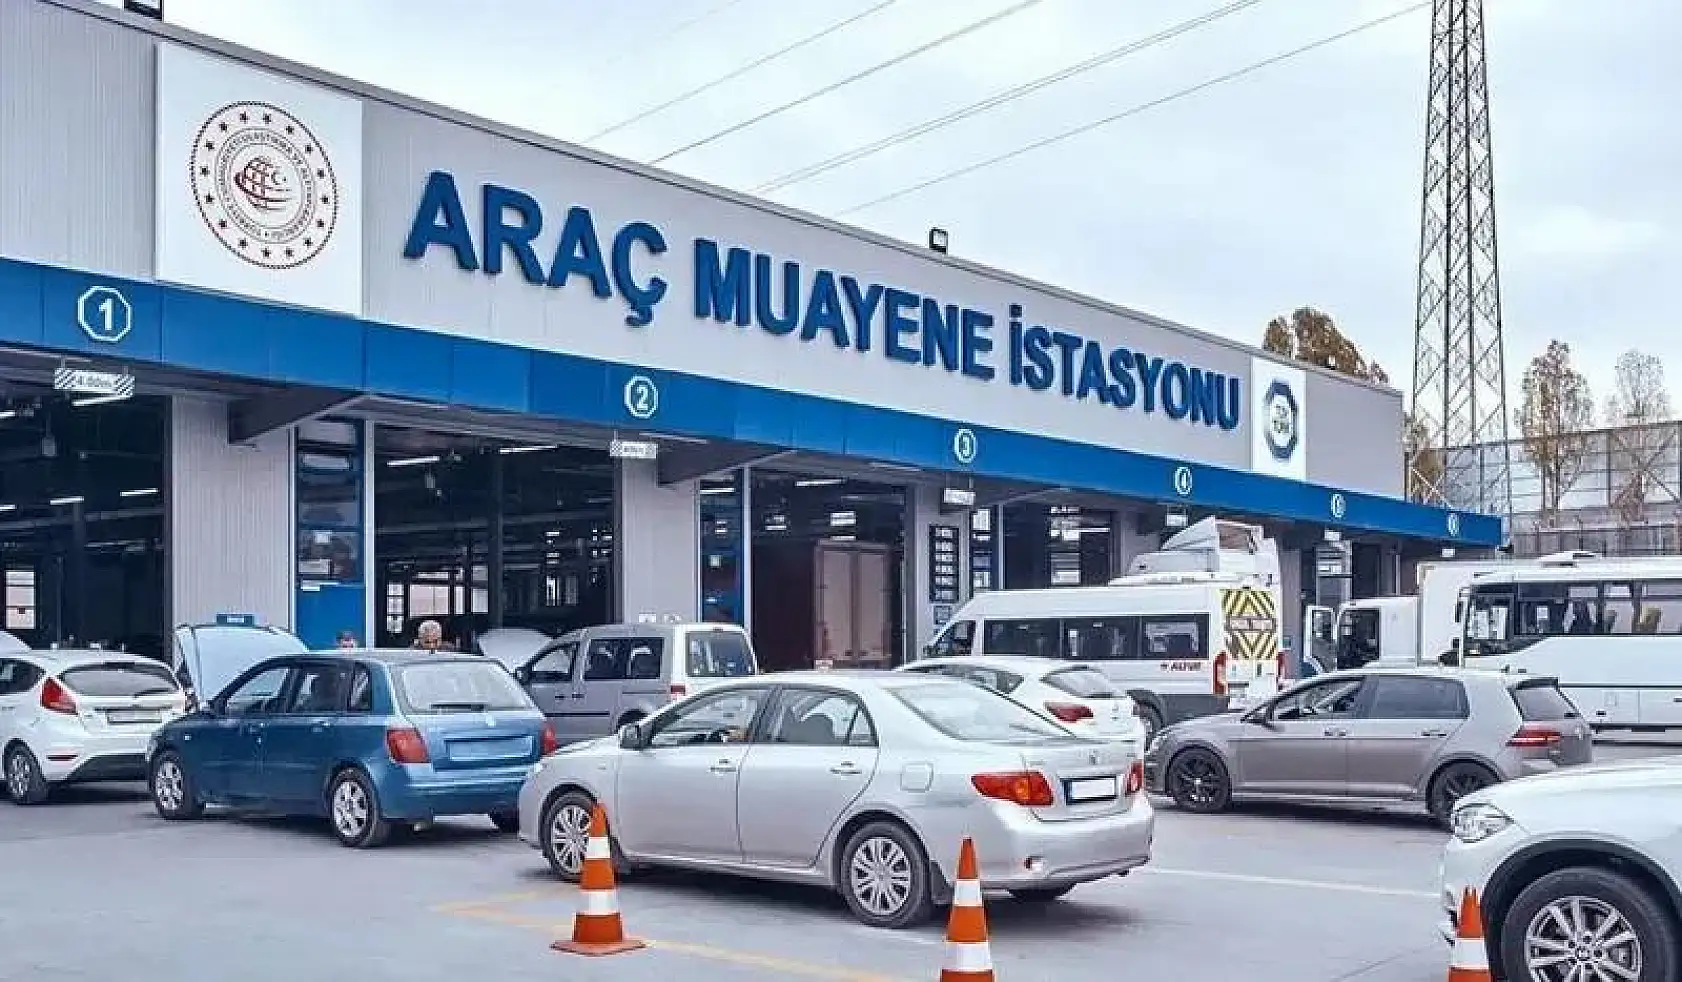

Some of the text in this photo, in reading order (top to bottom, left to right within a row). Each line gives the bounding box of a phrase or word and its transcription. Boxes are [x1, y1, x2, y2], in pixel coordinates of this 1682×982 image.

[99, 298, 112, 331] 1
[403, 170, 668, 327] ARAÇ
[694, 237, 995, 381] MUAYENE
[1008, 303, 1239, 431] İSTASYONU
[636, 385, 649, 411] 2
